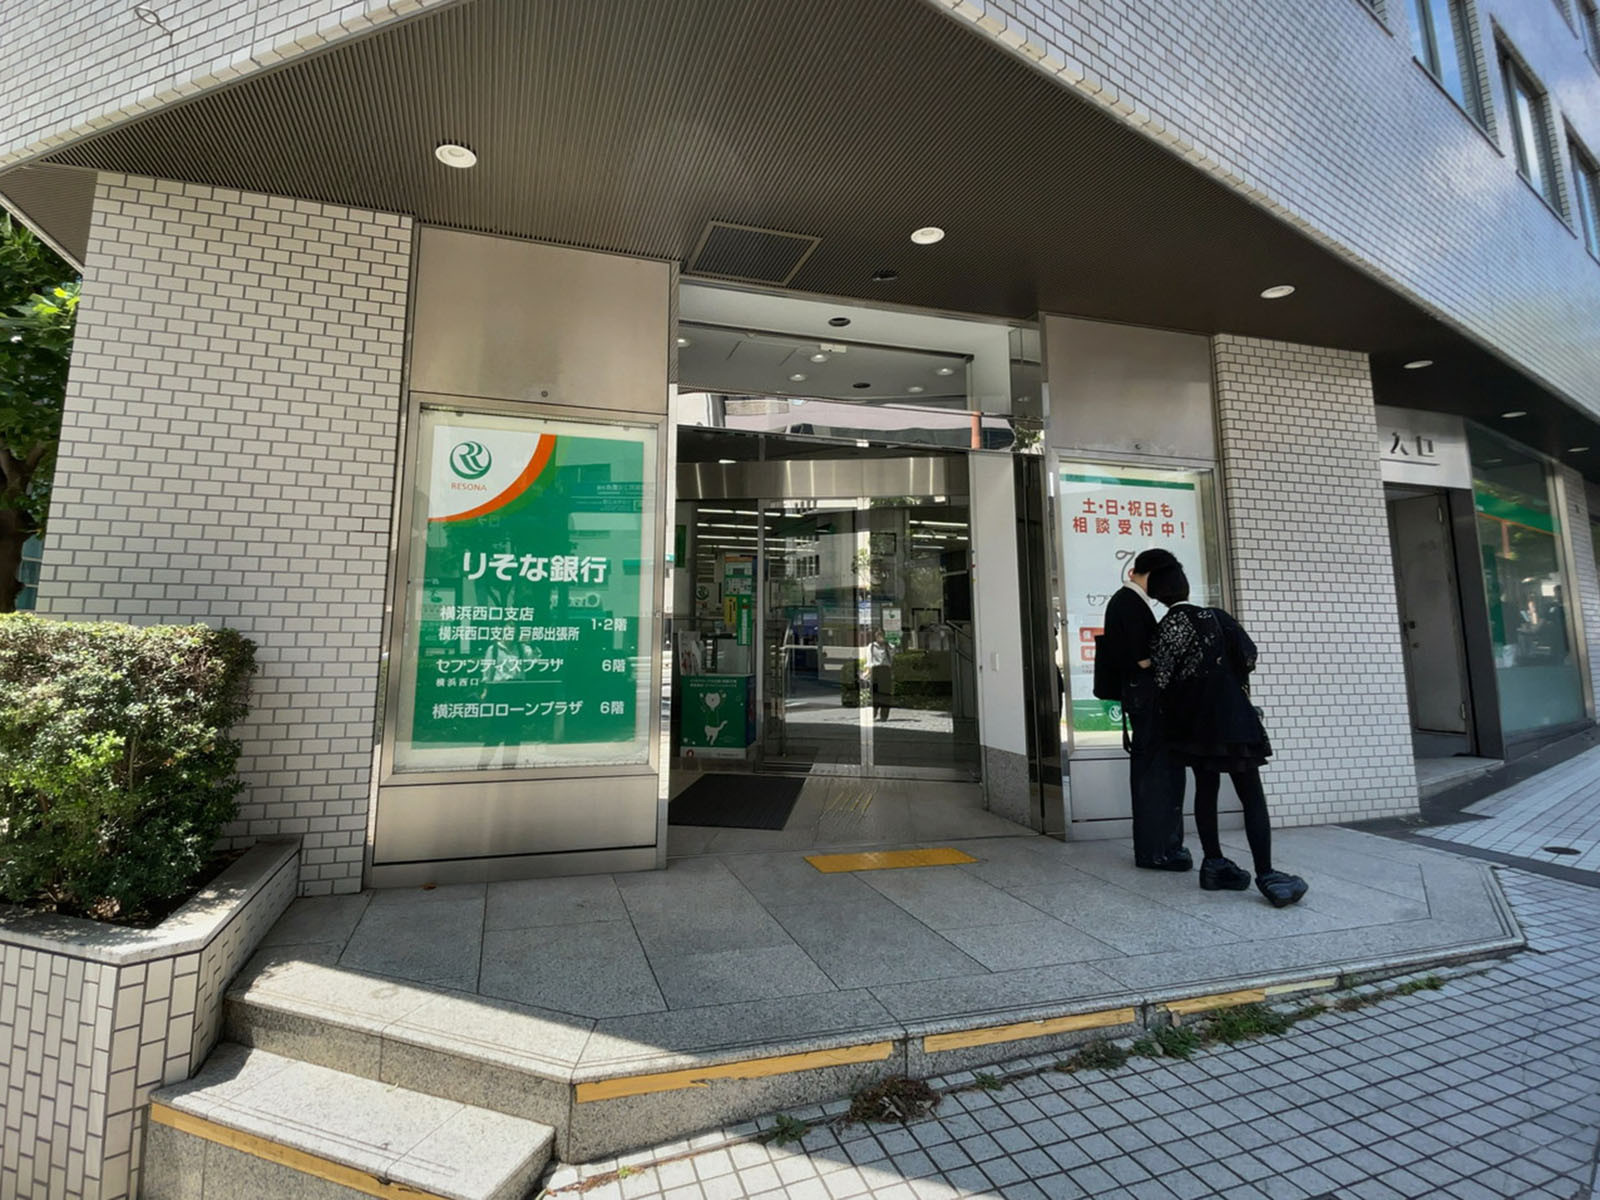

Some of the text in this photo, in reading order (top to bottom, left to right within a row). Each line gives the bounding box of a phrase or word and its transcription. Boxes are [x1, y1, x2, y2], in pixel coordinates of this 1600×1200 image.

[1390, 432, 1435, 457] 入口
[451, 482, 487, 491] RESONA
[463, 552, 607, 583] りそな銀行
[440, 606, 535, 621] 横浜西口支店
[438, 626, 580, 641] 横浜西口支店 戸部出張所
[602, 659, 626, 672] 6階
[436, 678, 479, 687] 横浜西口
[432, 700, 624, 719] 横浜西口ローンプラザ 6階
